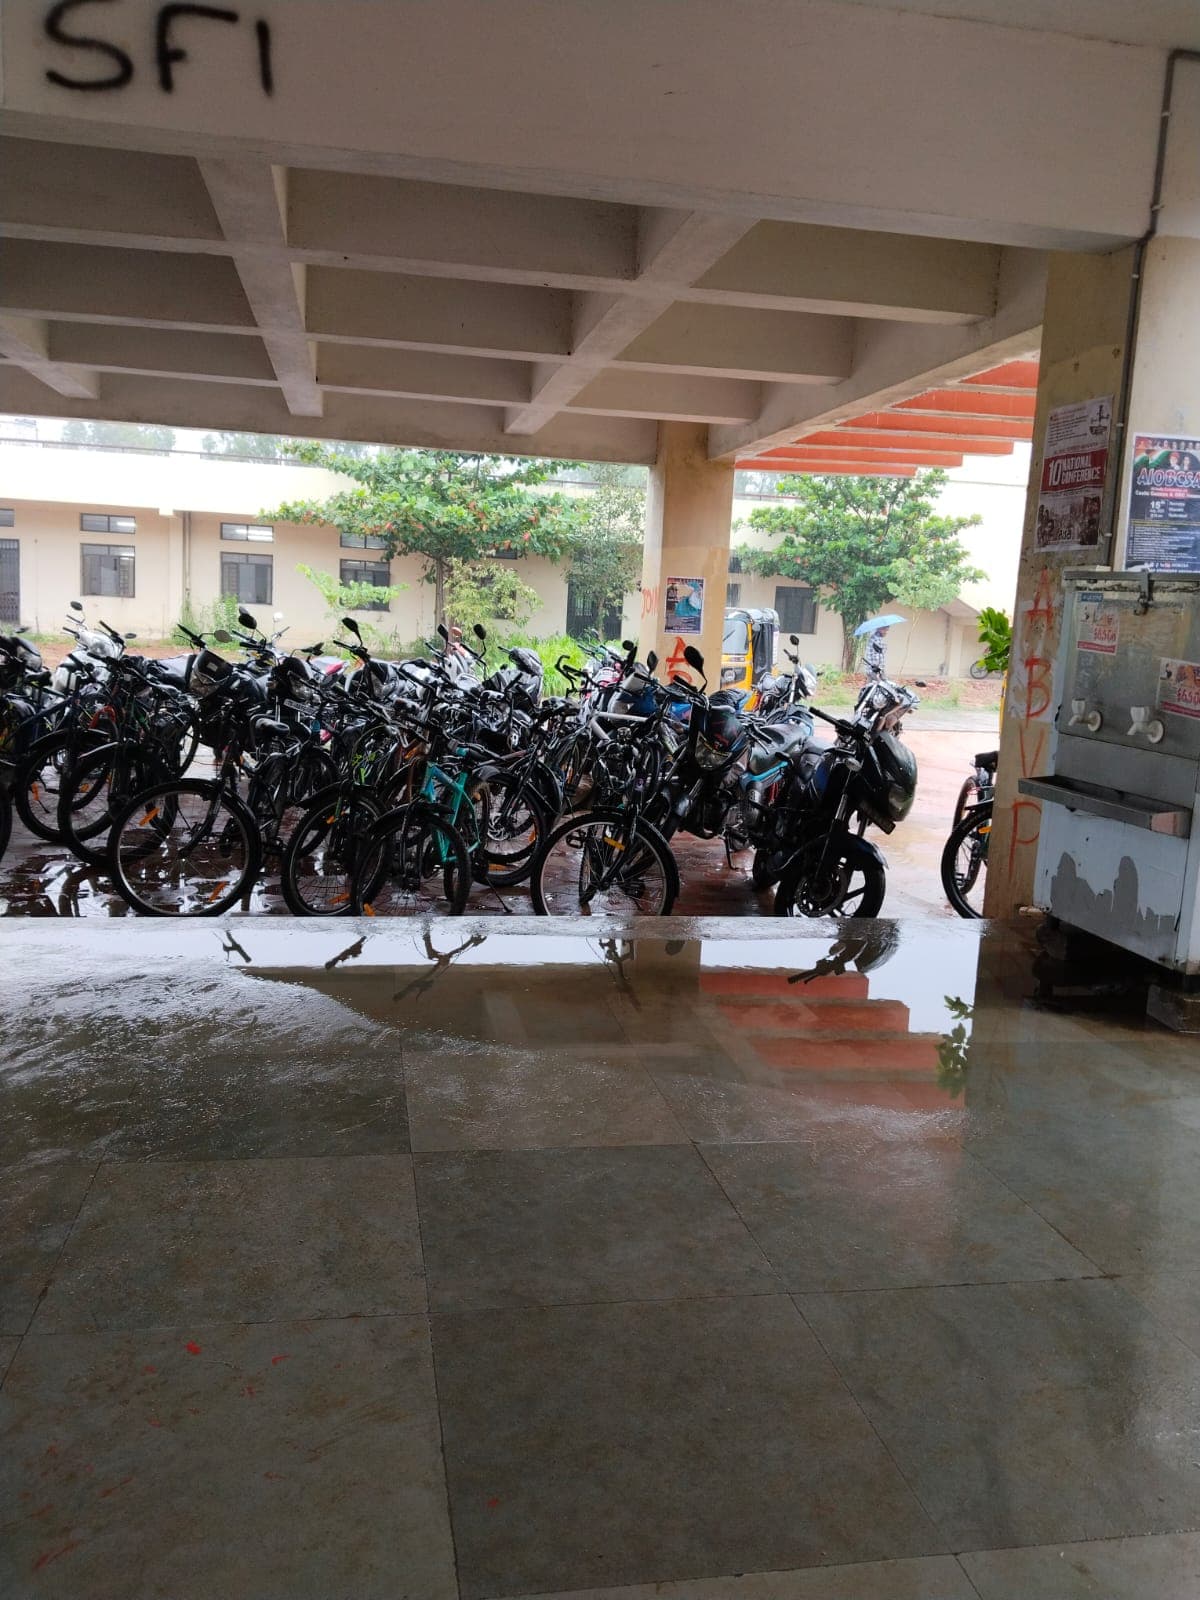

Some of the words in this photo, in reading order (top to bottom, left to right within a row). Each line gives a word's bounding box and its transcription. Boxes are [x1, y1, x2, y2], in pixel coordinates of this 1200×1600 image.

[44, 0, 274, 97] SFI
[1048, 460, 1061, 487] 10
[1062, 455, 1092, 470] NATIONAL
[1061, 467, 1101, 485] CONFERENCE
